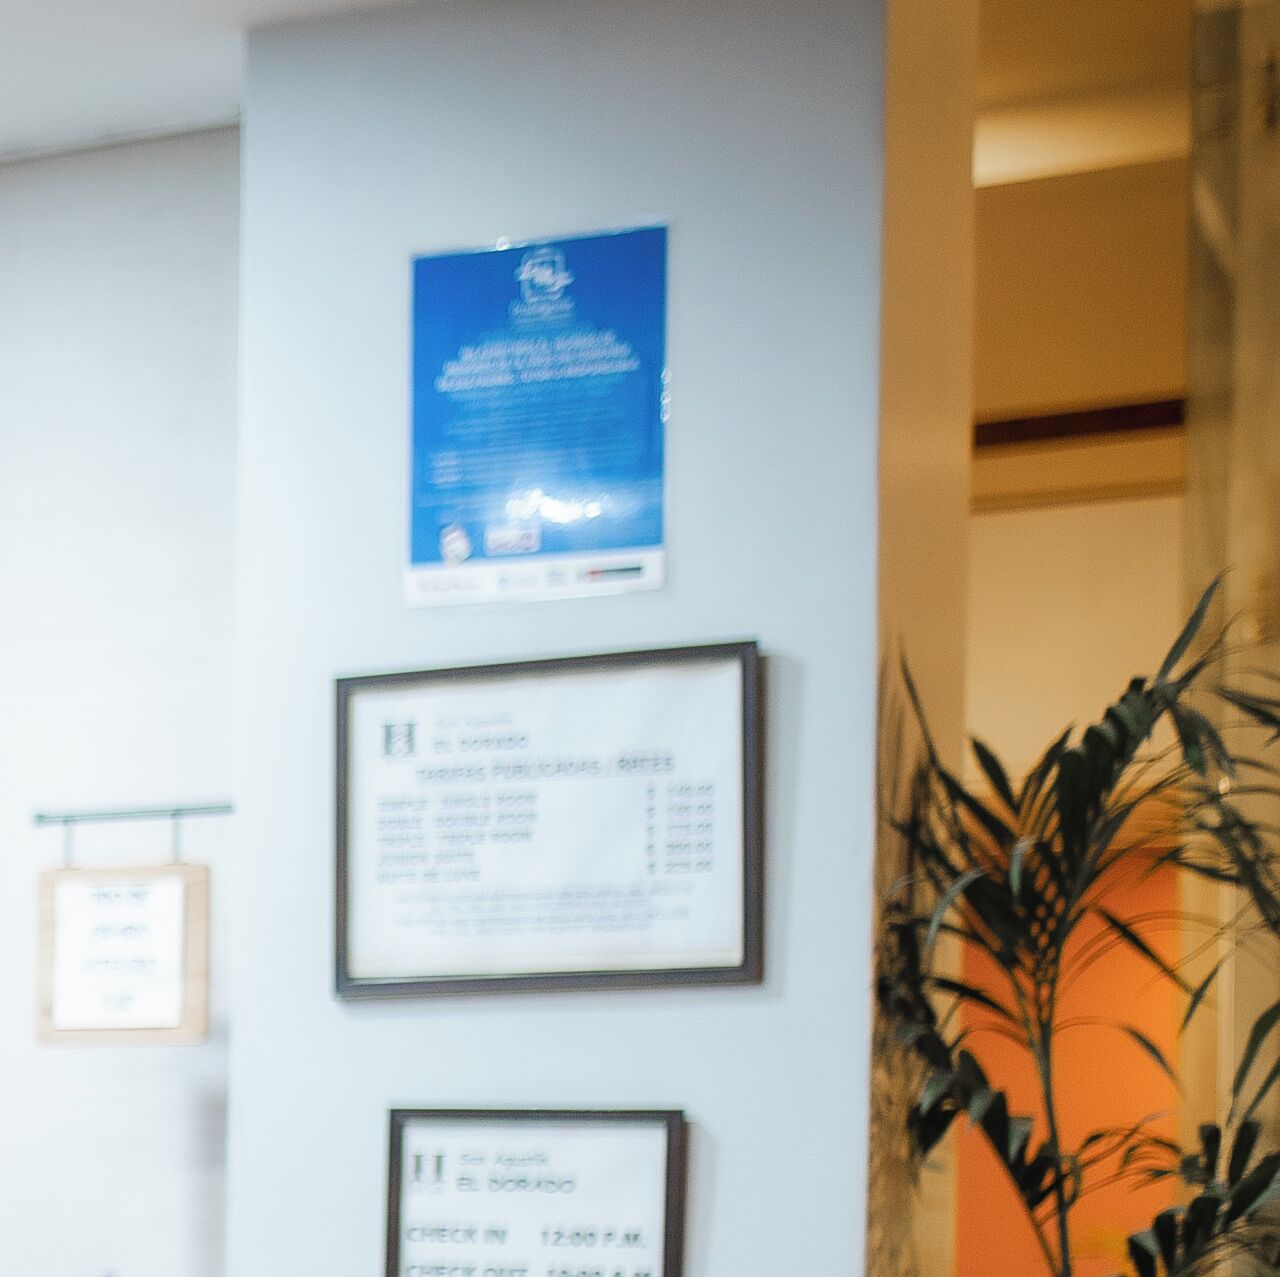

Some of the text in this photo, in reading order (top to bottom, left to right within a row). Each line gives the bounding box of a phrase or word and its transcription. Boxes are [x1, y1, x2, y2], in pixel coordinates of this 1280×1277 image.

[456, 1174, 578, 1195] EL DORADO
[406, 1224, 478, 1244] CHECK
[483, 1227, 509, 1247] IN
[540, 1228, 599, 1249] 12:00
